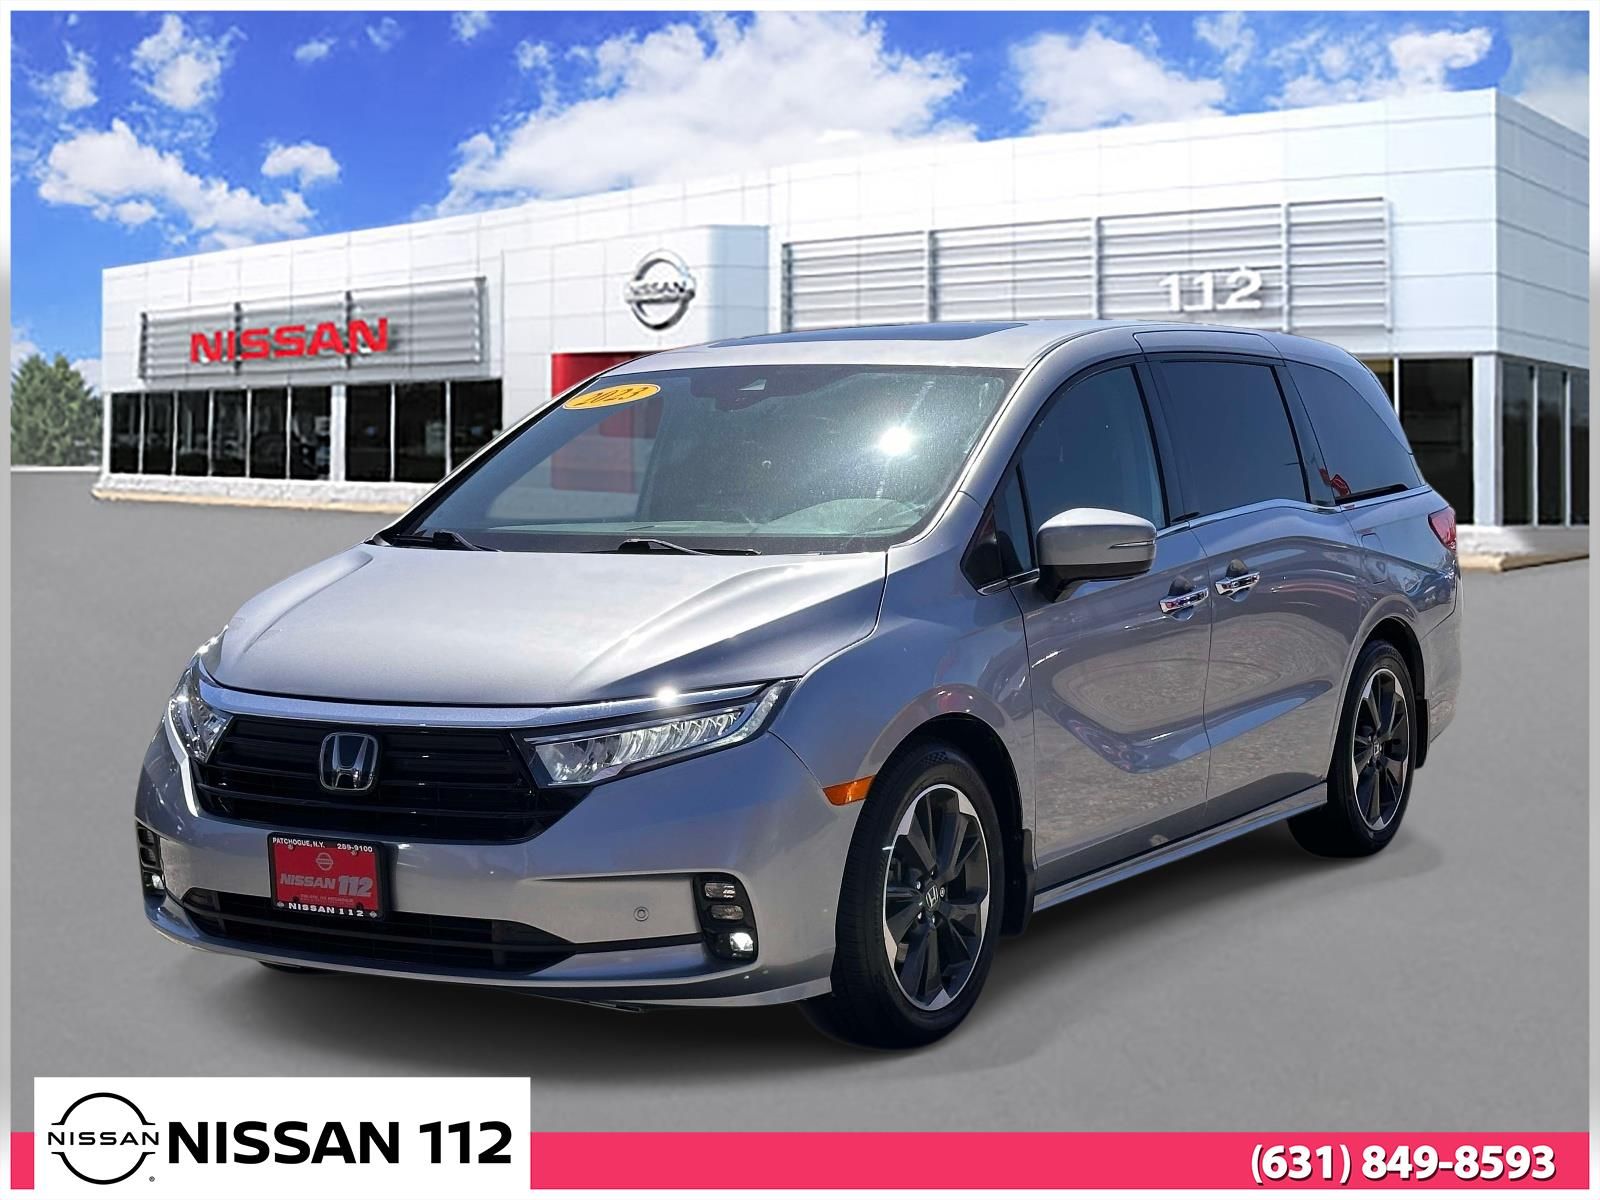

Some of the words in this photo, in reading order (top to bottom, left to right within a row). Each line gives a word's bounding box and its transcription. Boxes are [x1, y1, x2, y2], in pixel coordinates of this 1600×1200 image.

[1159, 268, 1263, 312] 112
[190, 317, 389, 363] NISSAN
[573, 386, 649, 406] 2023
[279, 873, 336, 889] NISSAN
[338, 875, 373, 898] 112
[288, 902, 336, 914] NISSAN
